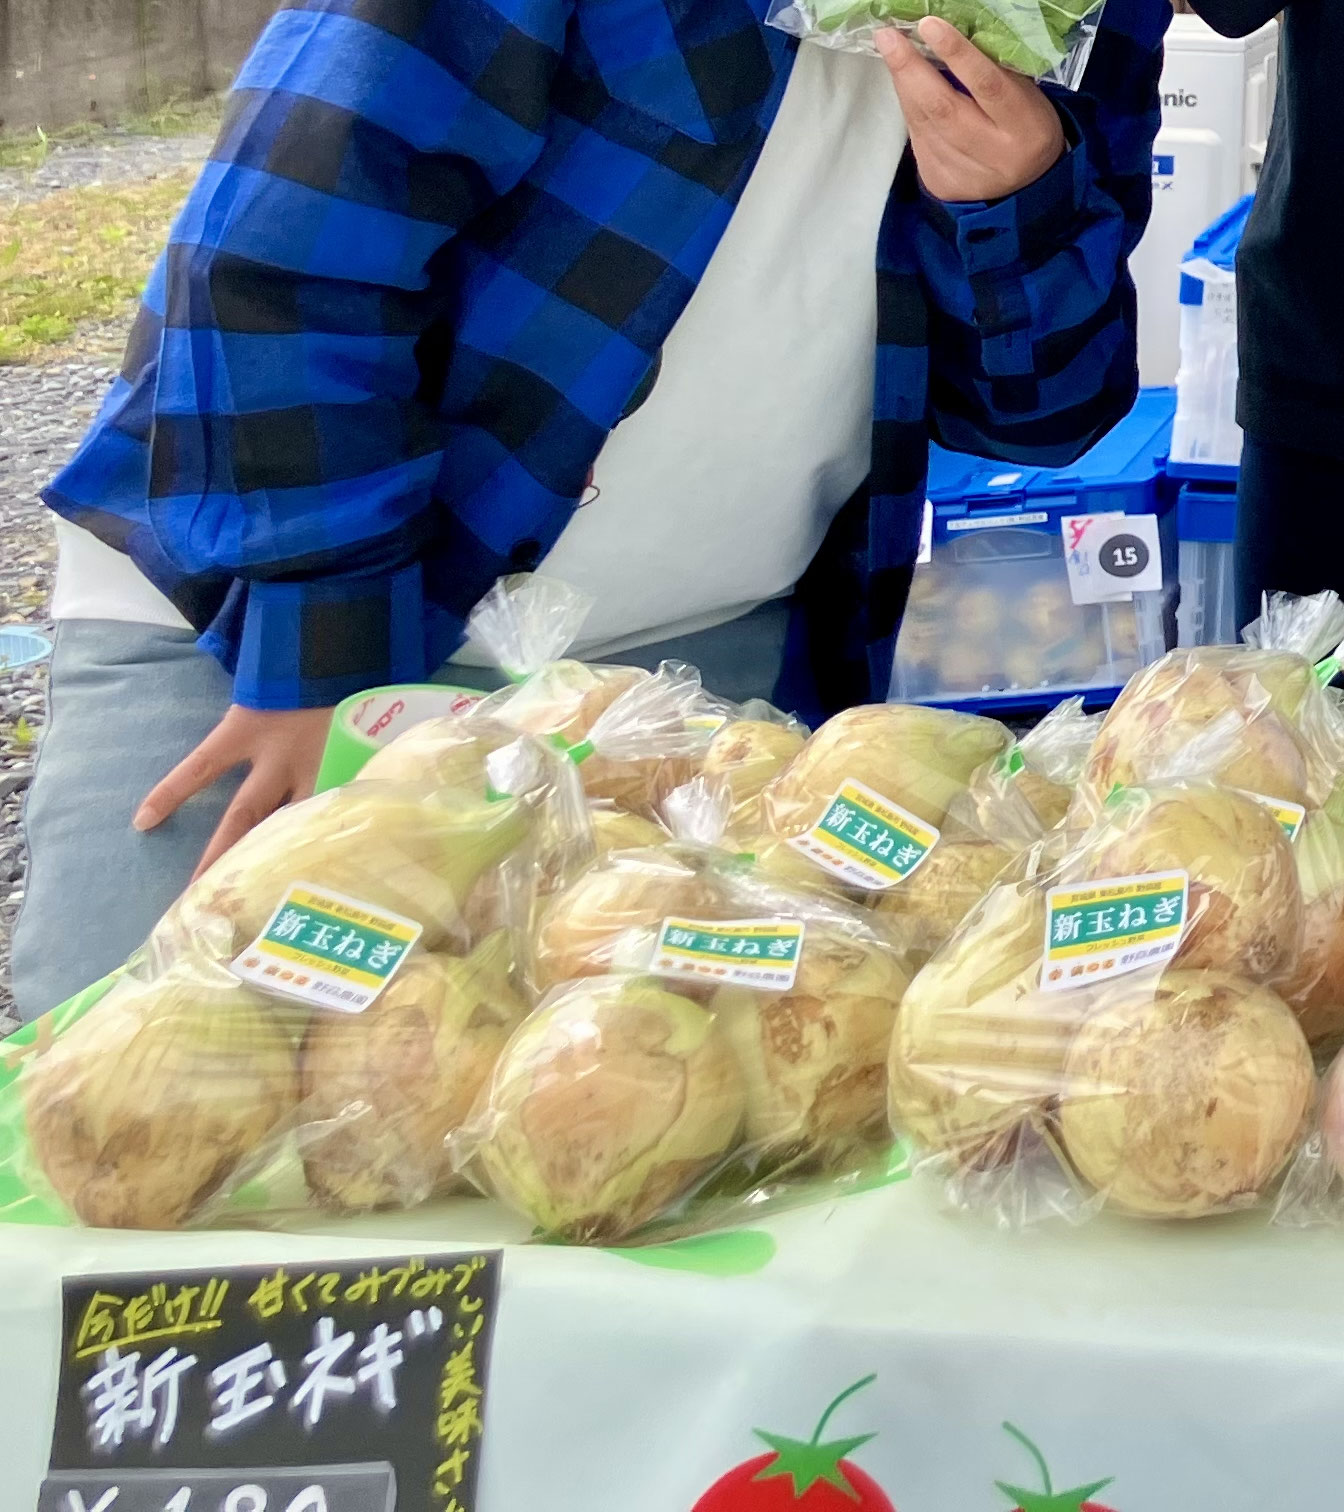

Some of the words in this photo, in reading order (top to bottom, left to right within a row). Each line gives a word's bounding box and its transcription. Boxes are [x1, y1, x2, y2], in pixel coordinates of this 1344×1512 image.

[1162, 88, 1198, 108] nic
[1111, 546, 1138, 567] 15
[824, 802, 922, 868] 新玉ねぎ
[271, 908, 403, 970] 新玉ねぎ
[667, 928, 796, 958] 新玉ねぎ
[1053, 895, 1182, 943] 新玉ねぎ
[87, 1305, 443, 1446] 新玉ネギ
